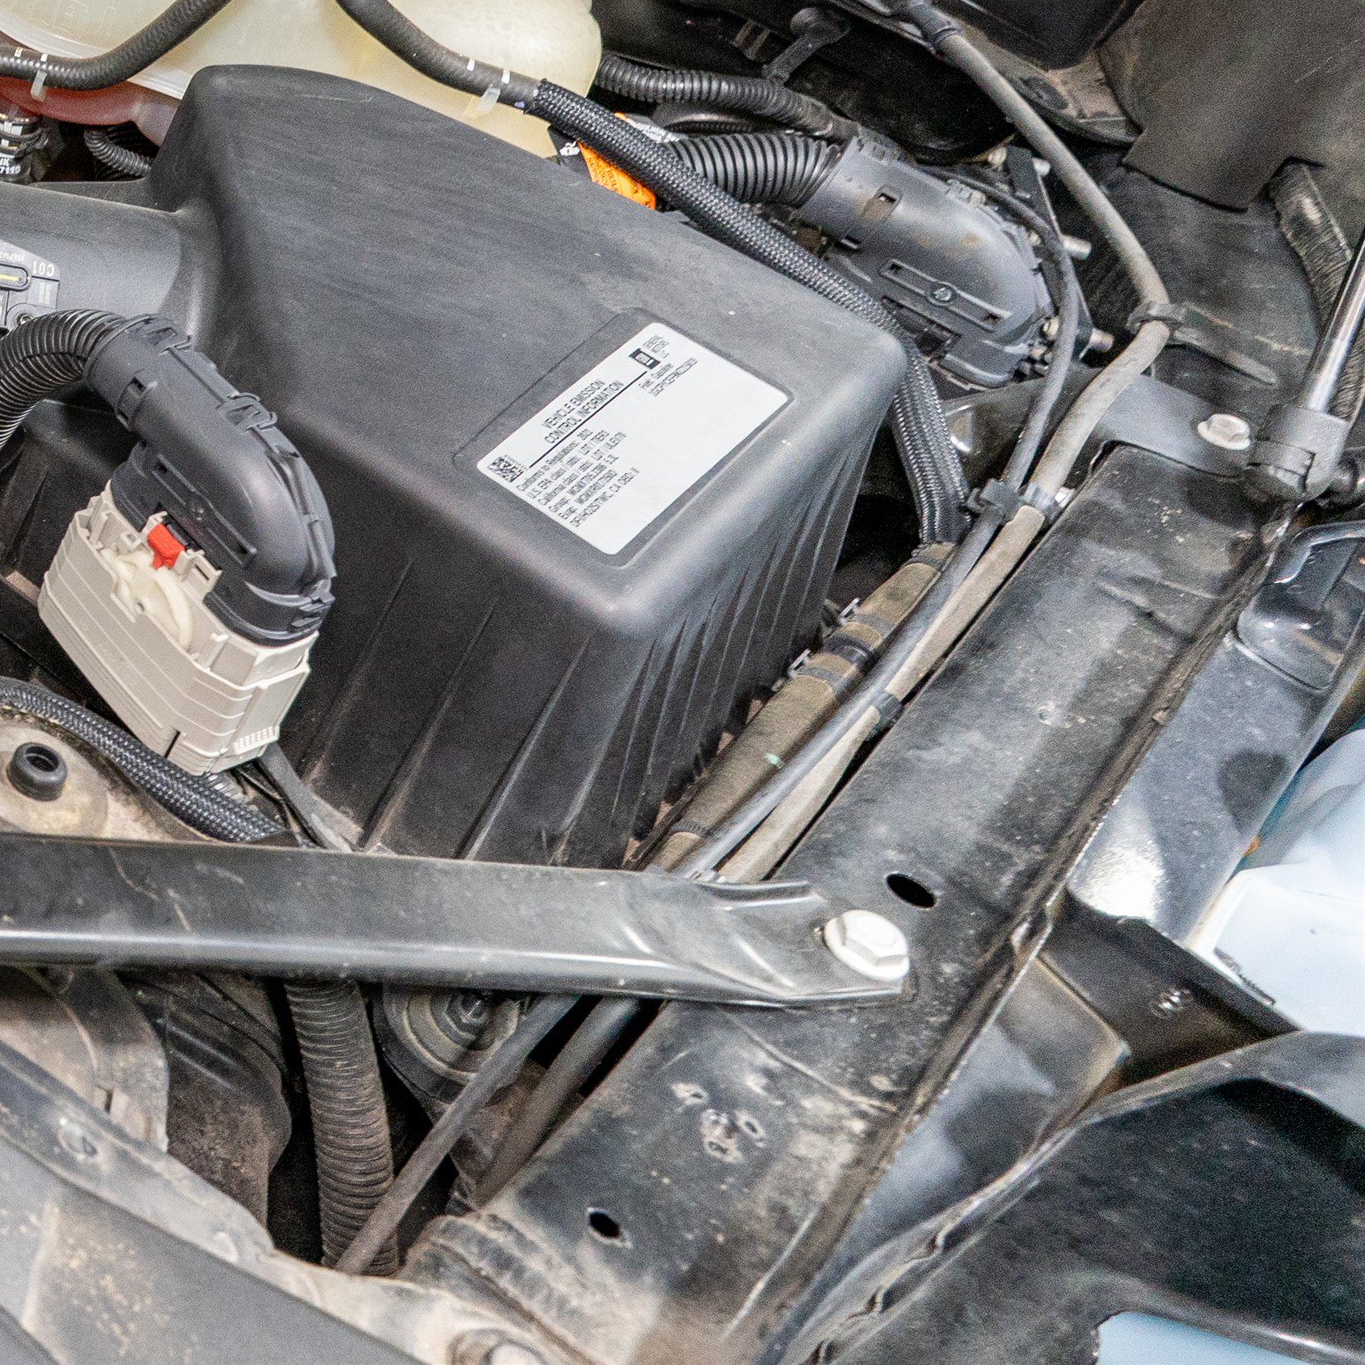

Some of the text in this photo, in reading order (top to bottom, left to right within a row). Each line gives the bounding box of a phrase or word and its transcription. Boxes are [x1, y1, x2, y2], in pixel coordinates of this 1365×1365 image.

[540, 378, 606, 430] VEHICLE EMISSION
[542, 378, 625, 444] CONTROL INFORMATION
[514, 467, 546, 492] Conforms
[538, 462, 551, 472] to
[536, 476, 553, 490] EPA
[547, 465, 567, 481] class
[536, 482, 566, 506] California
[559, 471, 579, 486] class
